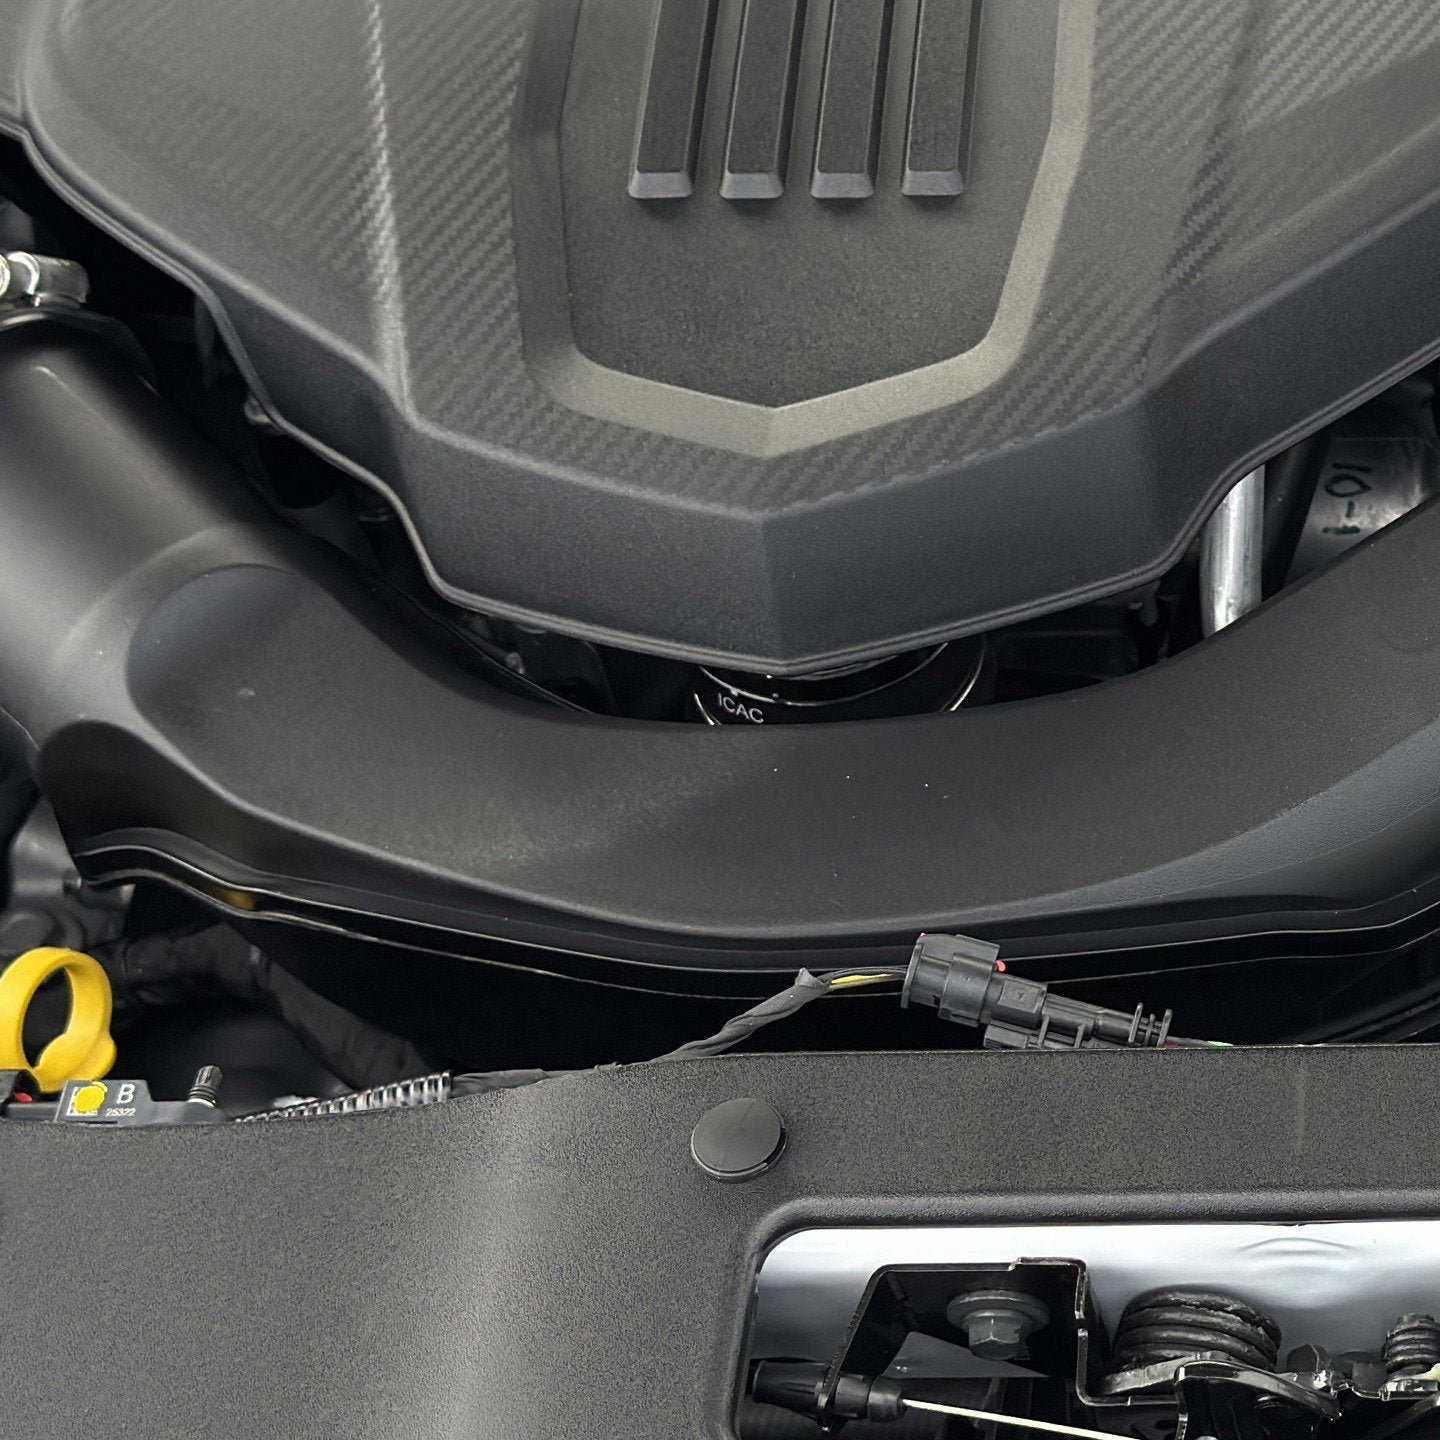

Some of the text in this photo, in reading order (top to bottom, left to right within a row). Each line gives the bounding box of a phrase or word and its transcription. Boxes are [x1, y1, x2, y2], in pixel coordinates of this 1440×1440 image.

[718, 692, 765, 724] ICAC
[116, 1083, 136, 1104] B
[104, 1107, 137, 1117] 25322
